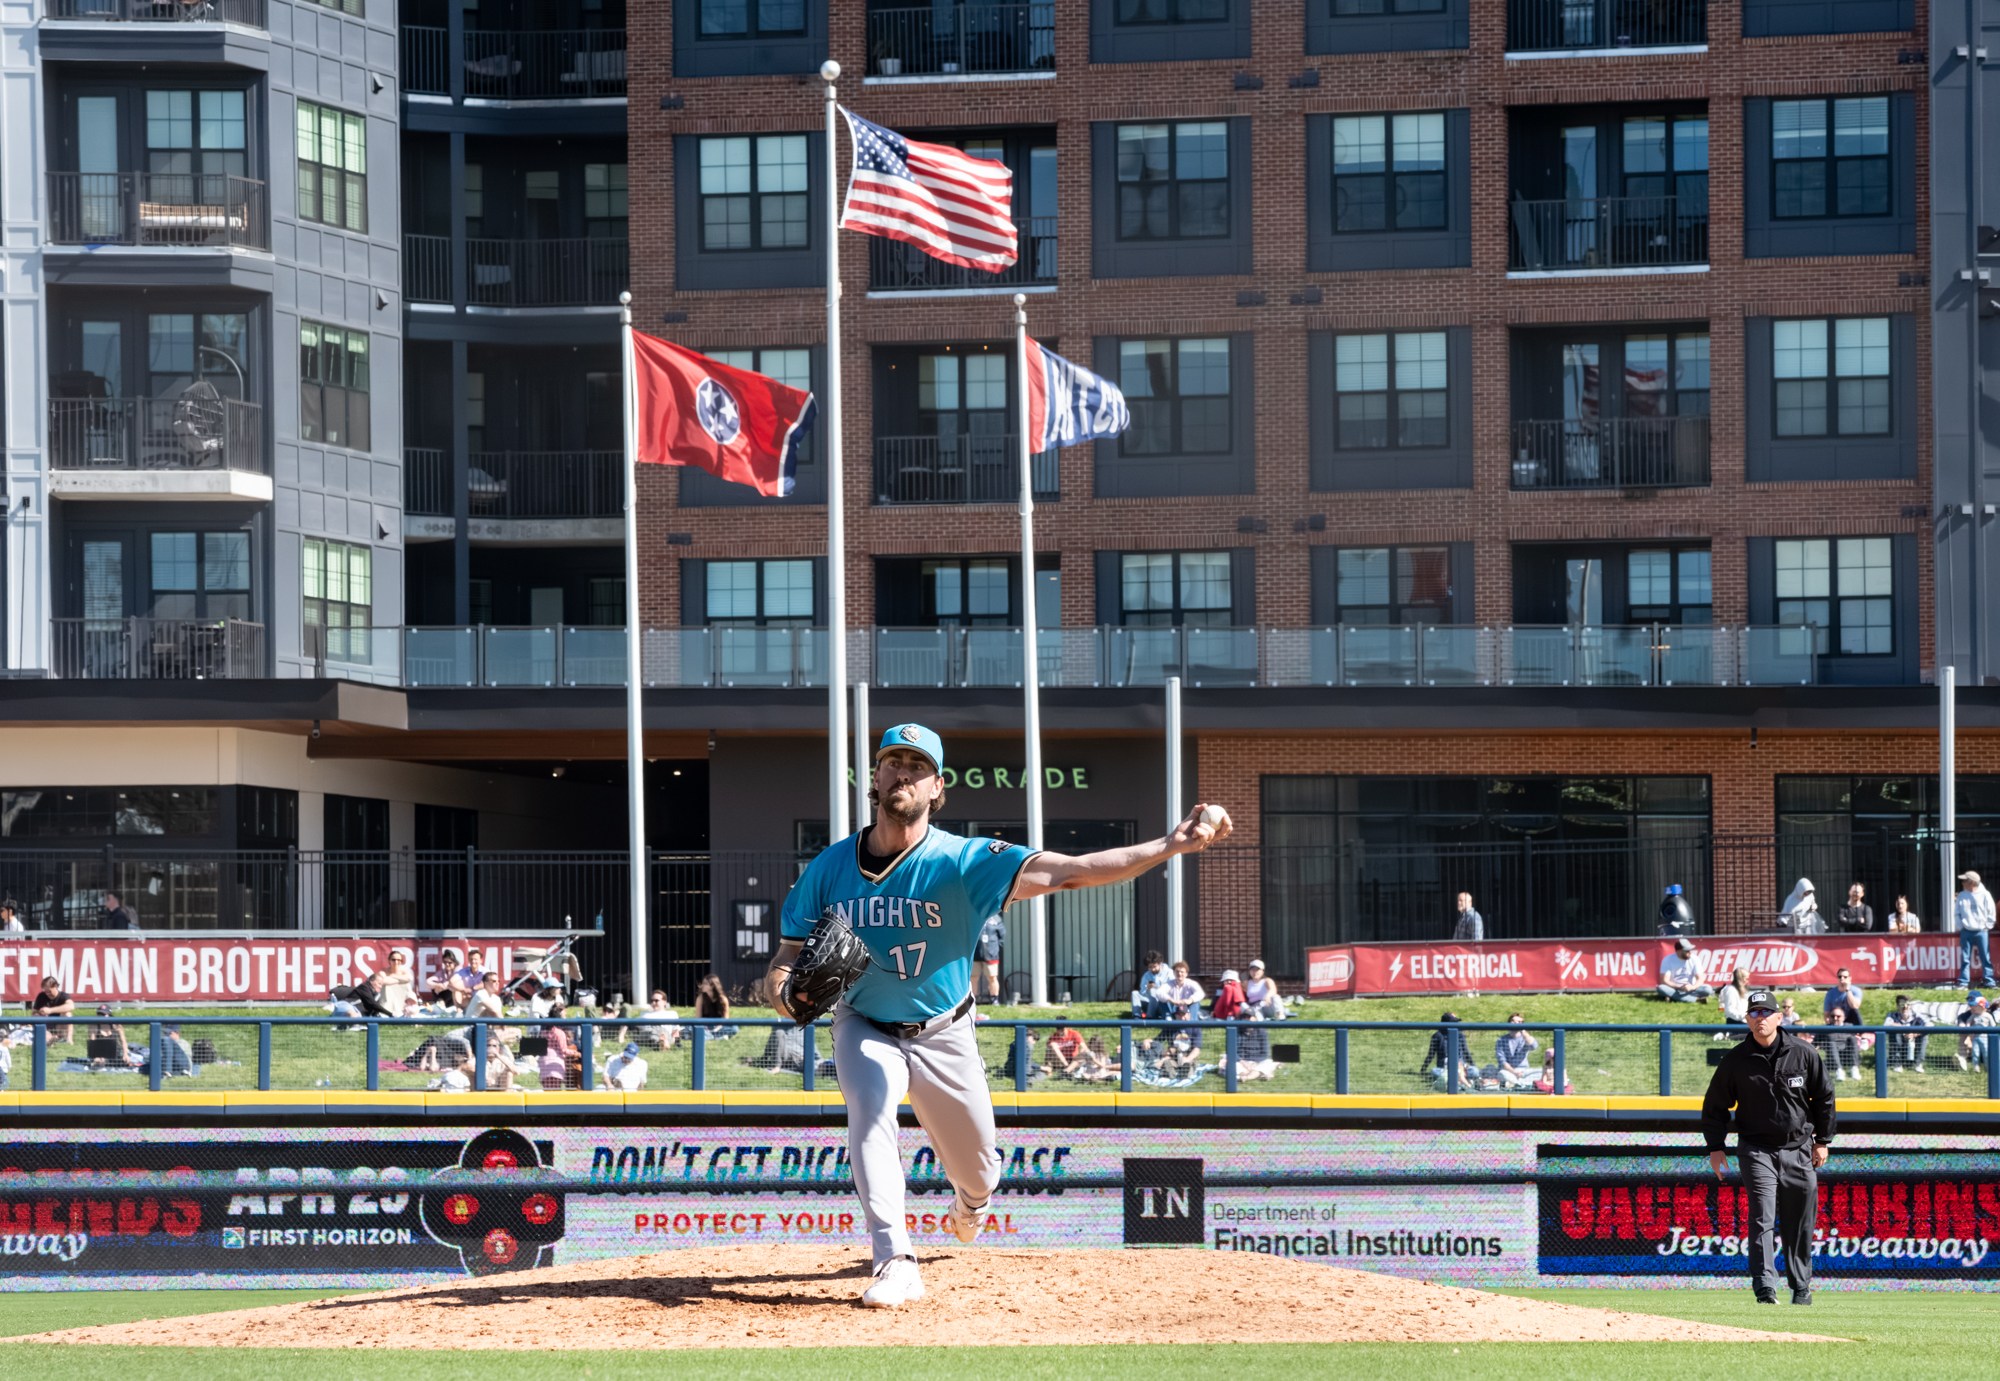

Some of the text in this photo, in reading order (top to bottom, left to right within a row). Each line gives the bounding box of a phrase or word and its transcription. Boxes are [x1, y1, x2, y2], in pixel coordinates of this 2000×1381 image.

[847, 767, 1089, 789] ROGRDE
[826, 895, 943, 929] NIGHTS
[173, 946, 377, 994] BROTHERS
[888, 940, 928, 980] 17
[1410, 953, 1523, 979] ELECTRICAL
[1594, 951, 1647, 976] HVAC
[1699, 947, 1799, 973] OFFMANN
[590, 1142, 702, 1196] DON'T
[994, 1146, 1071, 1195] ASE
[1134, 1186, 1192, 1219] TN
[1213, 1202, 1337, 1224] Department of
[1816, 1183, 2000, 1242] OBINS
[249, 1228, 309, 1246] FIRST
[634, 1212, 1019, 1235] PROTECT YOUR RSOAL
[1214, 1227, 1503, 1257] Financial Institutions
[1656, 1226, 1783, 1257] Jers
